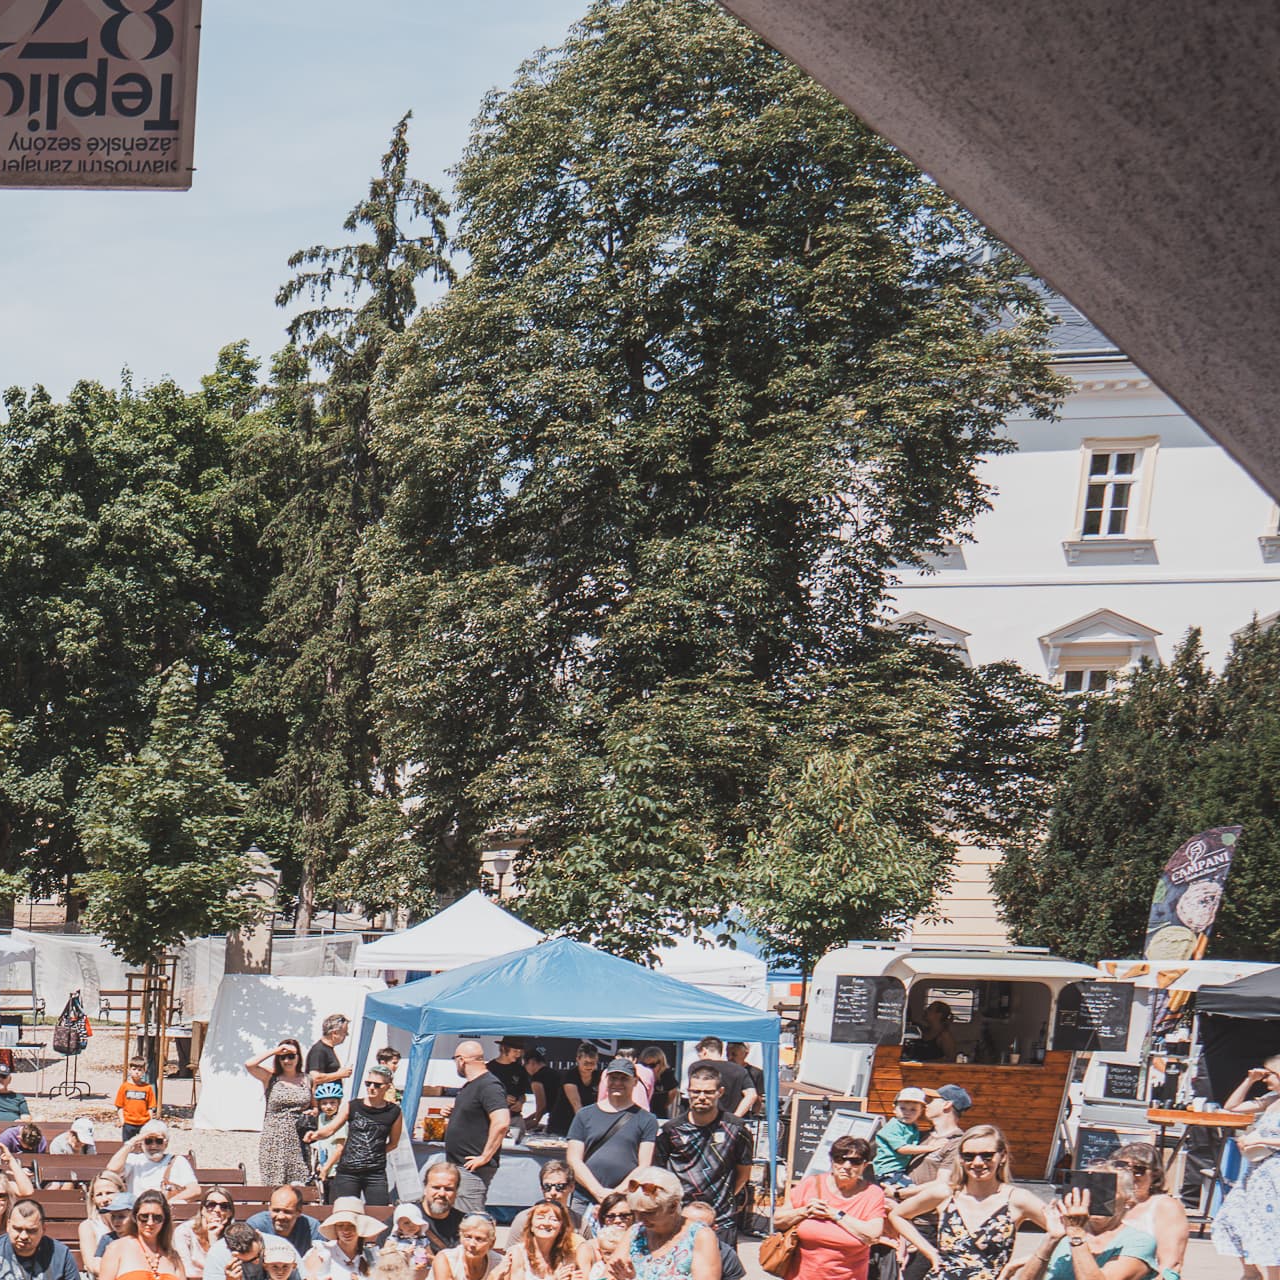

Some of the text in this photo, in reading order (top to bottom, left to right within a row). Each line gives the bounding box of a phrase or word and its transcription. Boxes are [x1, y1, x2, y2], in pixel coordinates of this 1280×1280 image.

[8, 132, 179, 156] ázeňské sezóny
[1171, 851, 1229, 882] CAMPANI
